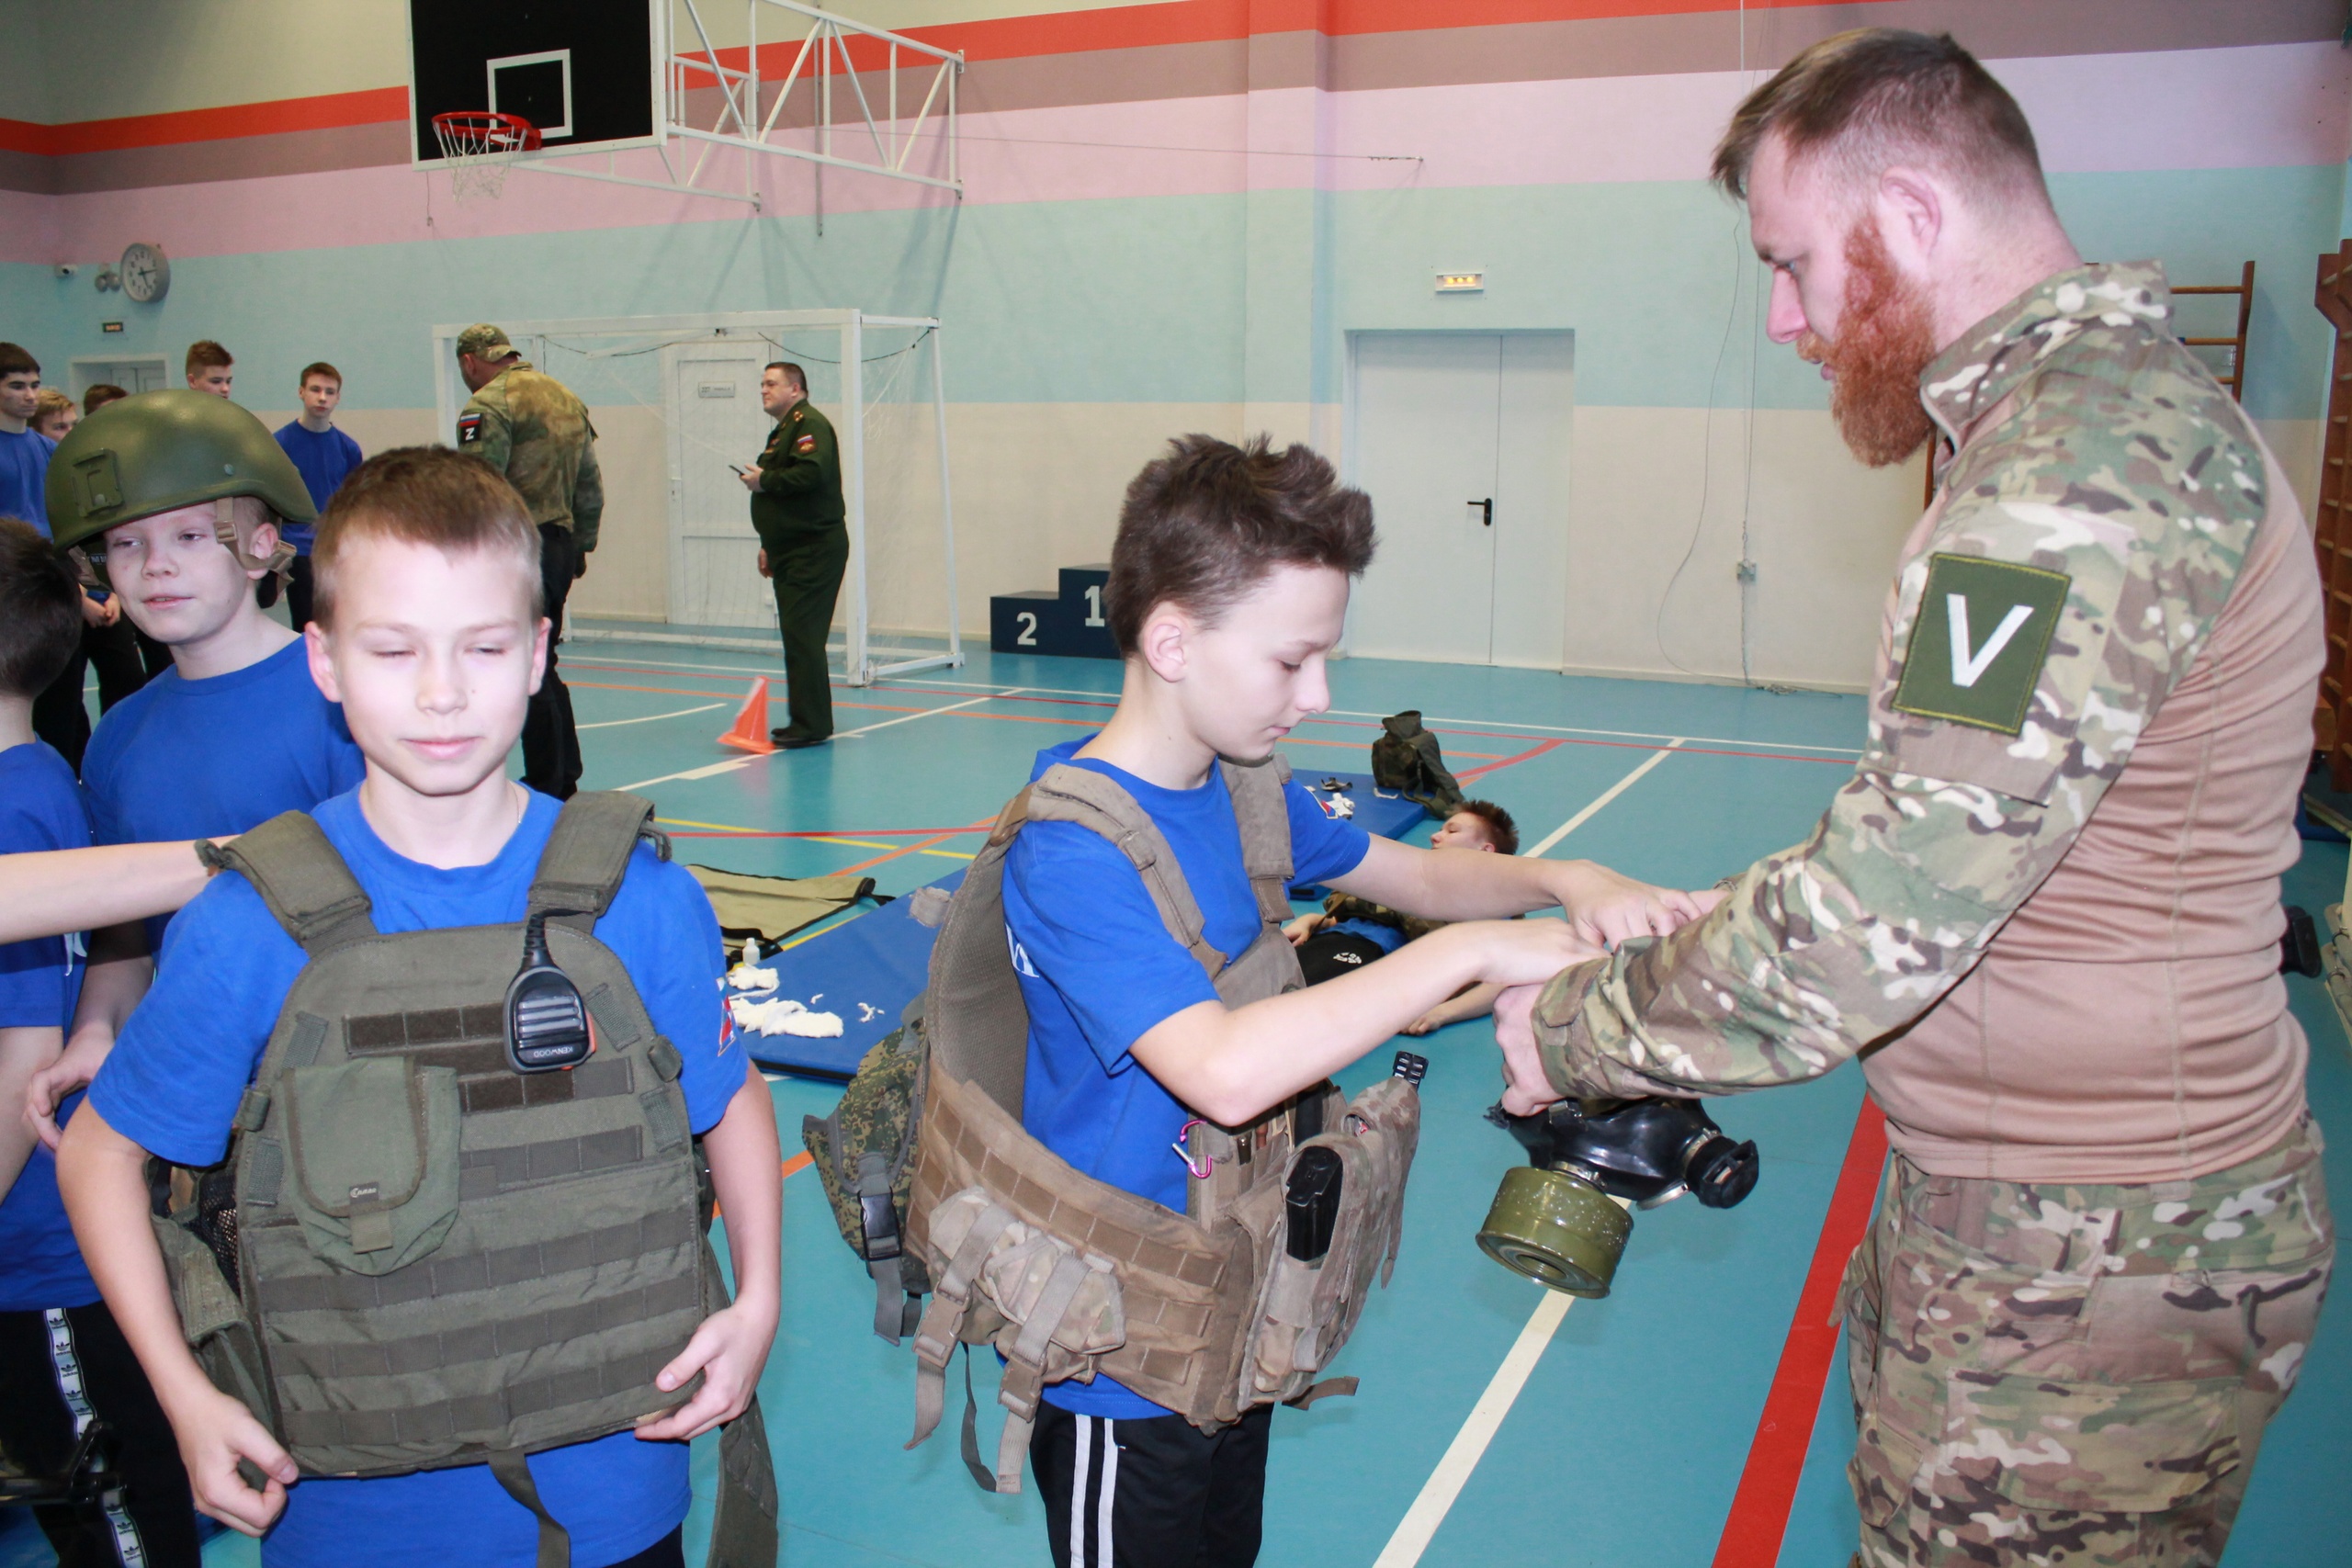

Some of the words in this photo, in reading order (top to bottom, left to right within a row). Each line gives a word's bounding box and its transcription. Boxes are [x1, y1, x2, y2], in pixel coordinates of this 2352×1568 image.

[465, 427, 475, 441] Z
[1085, 585, 1105, 627] 1
[1016, 612, 1037, 646] 2
[1946, 592, 2035, 687] V
[533, 1046, 573, 1058] KENWOOD
